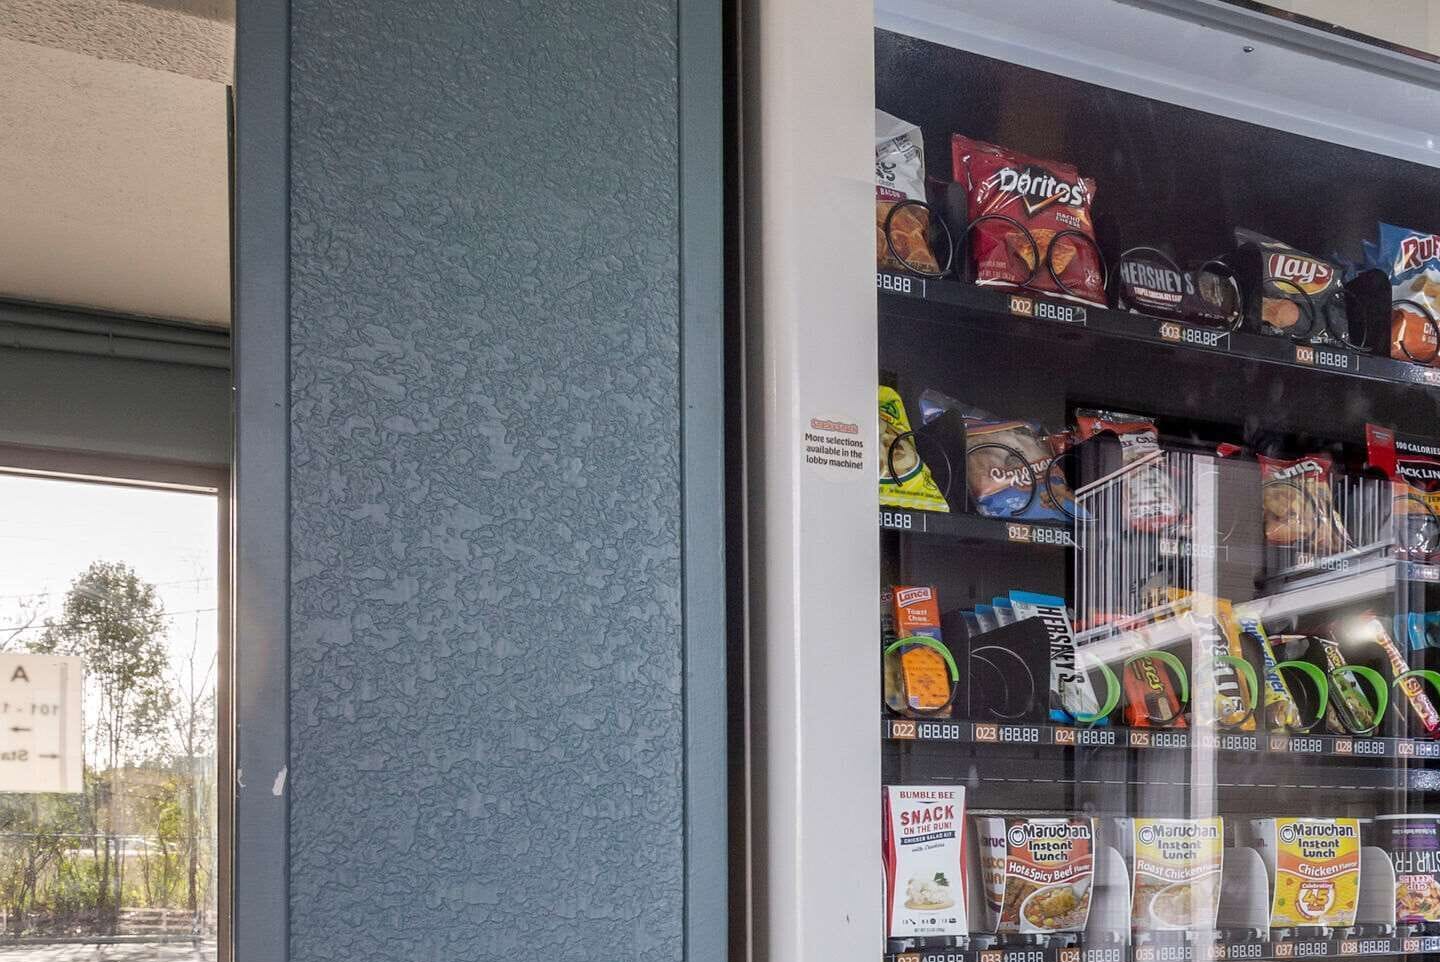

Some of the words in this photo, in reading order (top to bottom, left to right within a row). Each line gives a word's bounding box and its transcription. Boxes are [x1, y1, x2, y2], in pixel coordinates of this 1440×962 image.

[999, 167, 1084, 206] Doritos
[1056, 212, 1081, 222] NACHO
[805, 433, 825, 443] More
[826, 436, 863, 448] selections
[806, 445, 840, 456] available
[850, 450, 862, 458] the
[1407, 443, 1440, 456] CALORIES
[806, 455, 828, 465] lobby
[1395, 464, 1420, 478] JACK
[899, 590, 929, 602] Lance
[900, 791, 936, 799] BUMBLE
[938, 791, 956, 799] BEE
[901, 805, 954, 826] SNACK
[904, 826, 914, 835] ON
[917, 824, 931, 834] THE
[1024, 824, 1090, 840] Maruchan
[1154, 824, 1217, 838] Maruchan
[1293, 823, 1354, 837] Maruchan
[1029, 840, 1073, 851] Instant
[1158, 840, 1202, 849] Instant
[1298, 839, 1340, 848] Instant
[1034, 851, 1068, 862] Lunch
[1162, 850, 1197, 859] Lunch
[1303, 849, 1336, 858] Lunch
[1054, 865, 1073, 881] Beef
[1137, 860, 1163, 876] Roast
[1164, 864, 1202, 879] Chicken
[1298, 863, 1338, 877] Chicken
